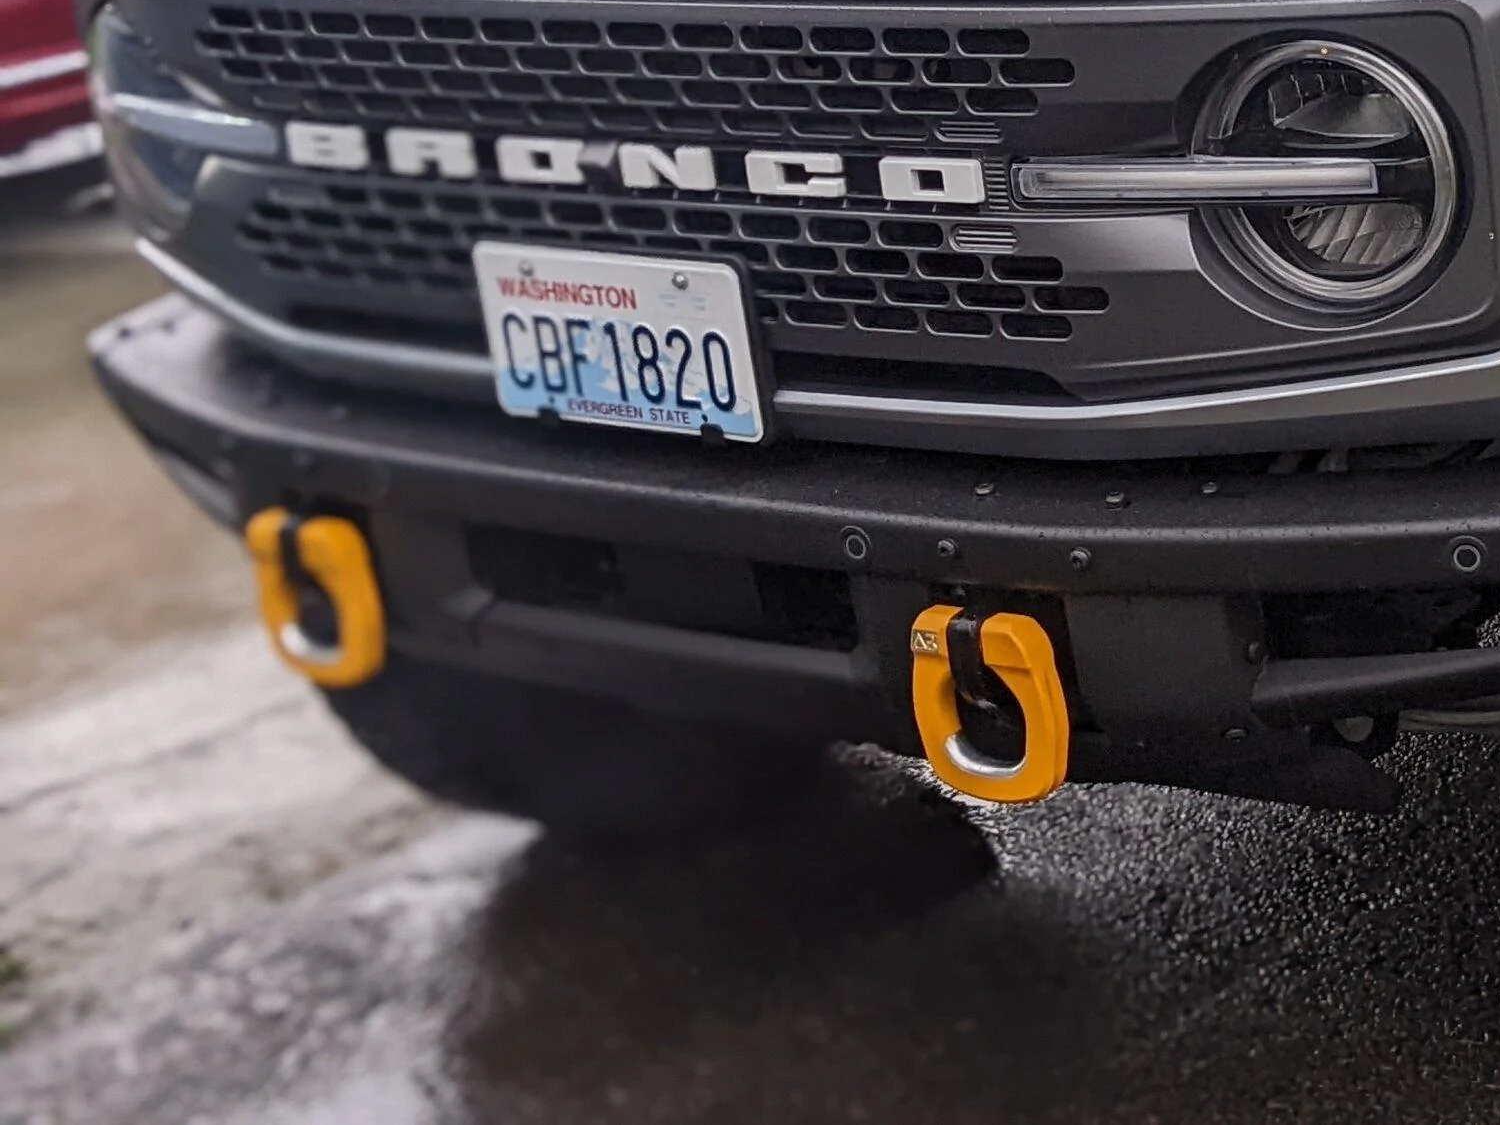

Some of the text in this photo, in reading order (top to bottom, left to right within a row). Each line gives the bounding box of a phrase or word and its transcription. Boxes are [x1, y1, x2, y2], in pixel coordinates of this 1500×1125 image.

[284, 120, 986, 205] BRONCO
[496, 276, 638, 311] WASHINGTON
[503, 313, 737, 412] CBF1820
[567, 397, 691, 425] EVERGREEN STATE
